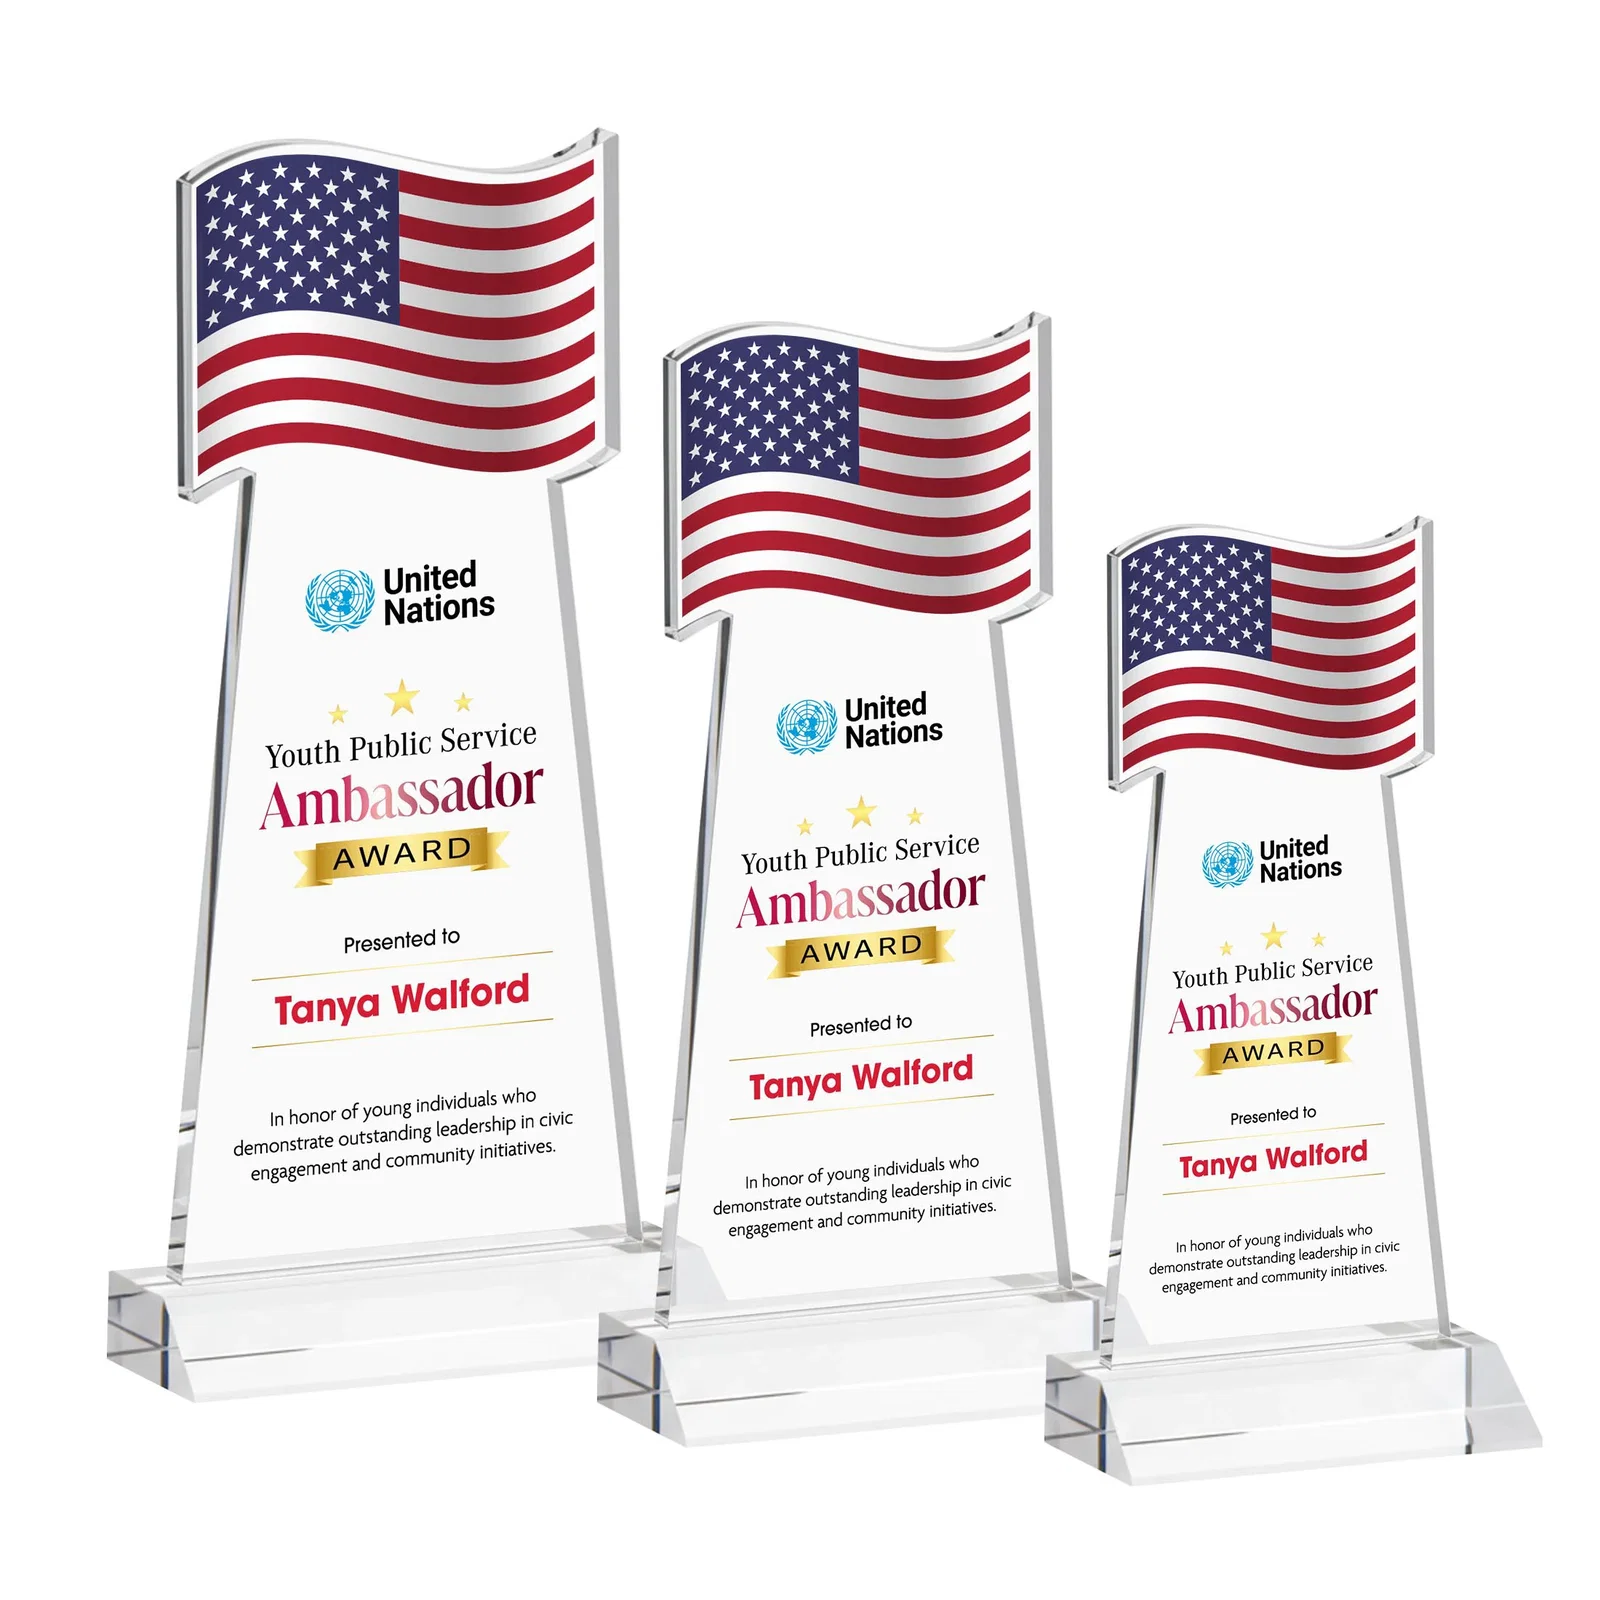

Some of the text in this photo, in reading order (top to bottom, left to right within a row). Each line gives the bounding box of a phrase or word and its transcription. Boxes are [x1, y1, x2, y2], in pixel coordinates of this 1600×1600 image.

[384, 559, 477, 595] United
[384, 594, 495, 626] Nations
[845, 690, 927, 723] United
[265, 722, 538, 769] Youth Public Service
[845, 720, 943, 750] Nations
[258, 761, 545, 831] Ambassador
[332, 836, 472, 871] AWARD
[741, 834, 980, 876] Youth Public Service
[1260, 833, 1329, 861] United
[1260, 859, 1343, 884] Nations
[735, 867, 986, 929] Ambassador
[344, 927, 461, 954] Presented to
[800, 934, 922, 965] AWARD
[1172, 954, 1374, 990] Youth Public Service
[274, 972, 530, 1026] Tanya Walford
[1168, 982, 1379, 1035] Ambassador
[810, 1014, 913, 1037] Presented to
[1222, 1039, 1325, 1064] AWARD
[749, 1053, 973, 1101] Tanya Walford
[270, 1087, 537, 1127] In honor of young individuals who
[1230, 1105, 1317, 1125] Presented to
[233, 1111, 574, 1157] demonstrate outstanding leadership in civic
[250, 1140, 557, 1184] engagement and community initiatives.
[745, 1153, 980, 1190] In honor of young individuals who
[1179, 1139, 1368, 1179] Tanya Walford
[713, 1175, 1012, 1216] demonstrate outstanding leadership in civic
[728, 1200, 997, 1240] engagement and community initiatives.
[1176, 1223, 1373, 1253] In honor of young individuals who
[1148, 1241, 1401, 1276] demonstrate outstanding leadership in civic
[1161, 1262, 1388, 1295] engagement and community initiatives.
